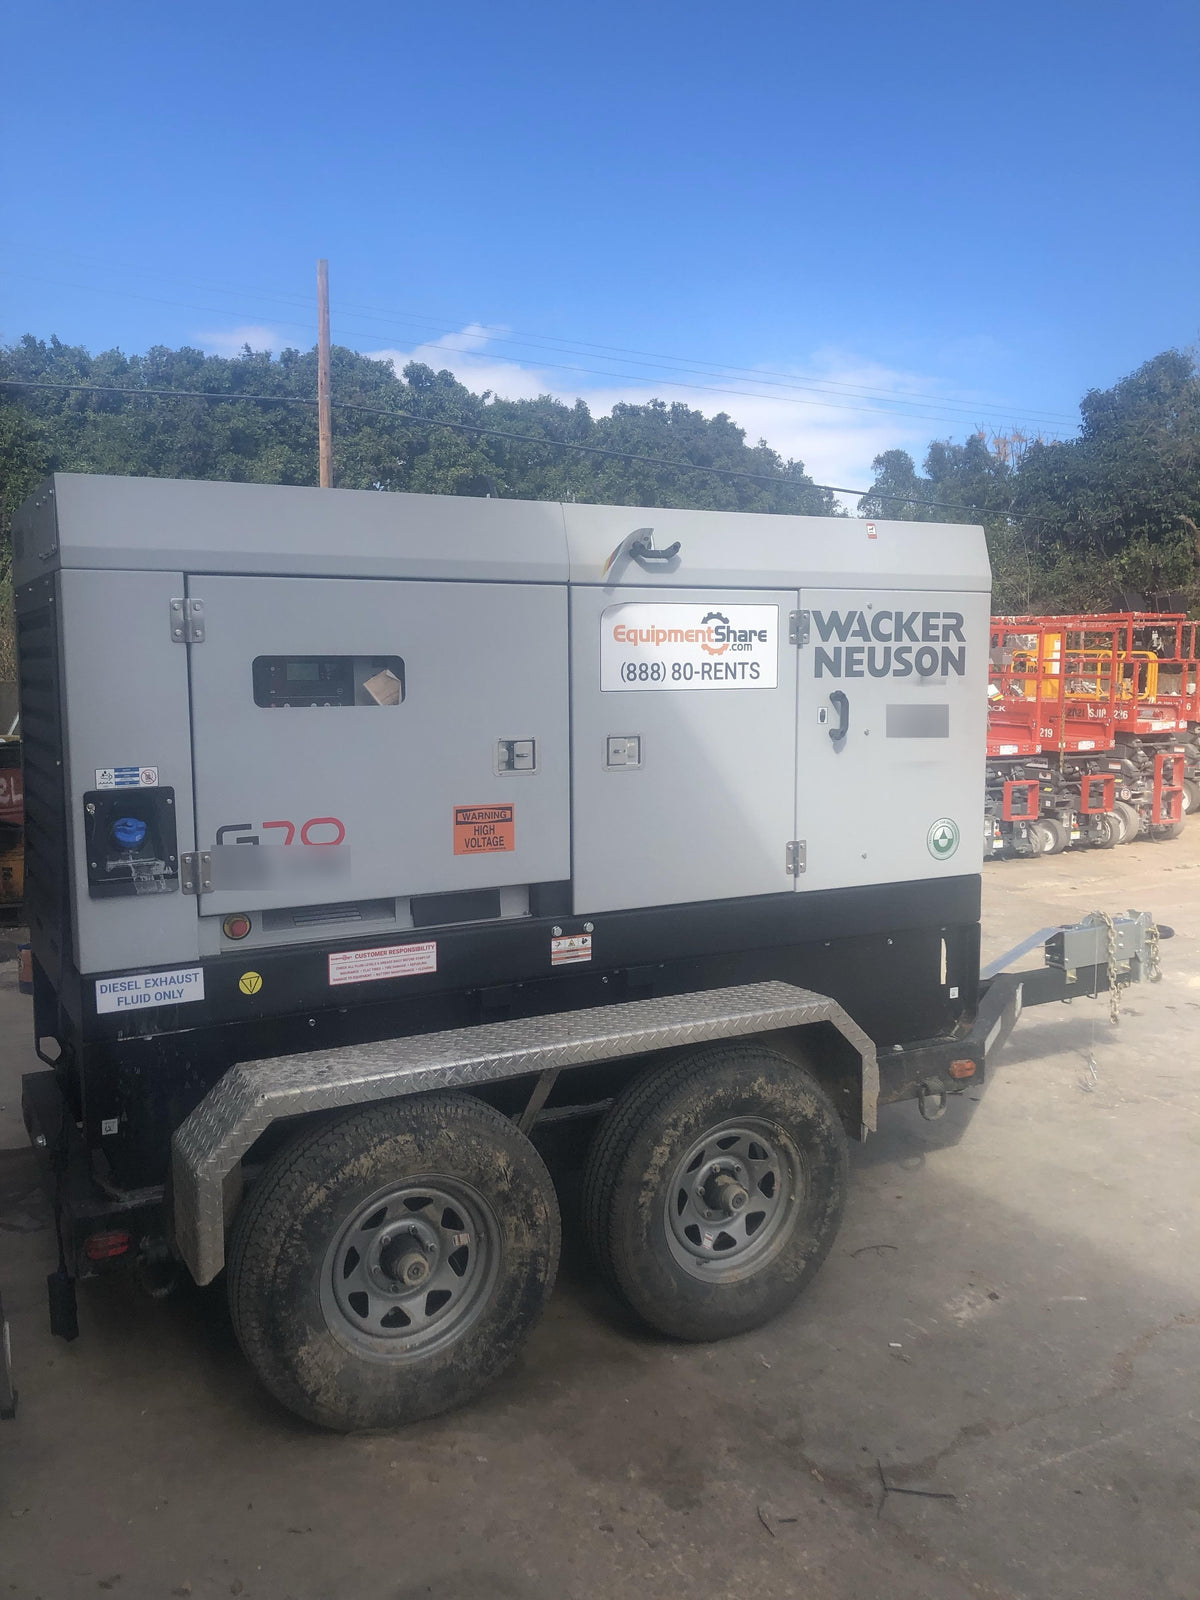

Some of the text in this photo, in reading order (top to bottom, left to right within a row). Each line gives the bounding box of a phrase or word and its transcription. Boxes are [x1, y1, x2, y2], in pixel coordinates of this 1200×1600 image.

[613, 624, 767, 646] EquipmentShare
[811, 610, 966, 642] WACKER
[729, 643, 753, 652] .com
[814, 645, 966, 678] NEUSON
[620, 661, 760, 682] (888) 80-RENTS
[1040, 727, 1053, 738] 219
[462, 811, 507, 821] WARNING
[216, 817, 345, 846] G70
[473, 824, 495, 836] HIGH
[464, 836, 505, 848] VOLTAGE
[354, 949, 388, 959] CUSTOMER
[388, 944, 435, 955] RESPONSIBILITY
[100, 973, 200, 994] DIESEL EXHAUST
[117, 988, 184, 1006] FLUID ONLY
